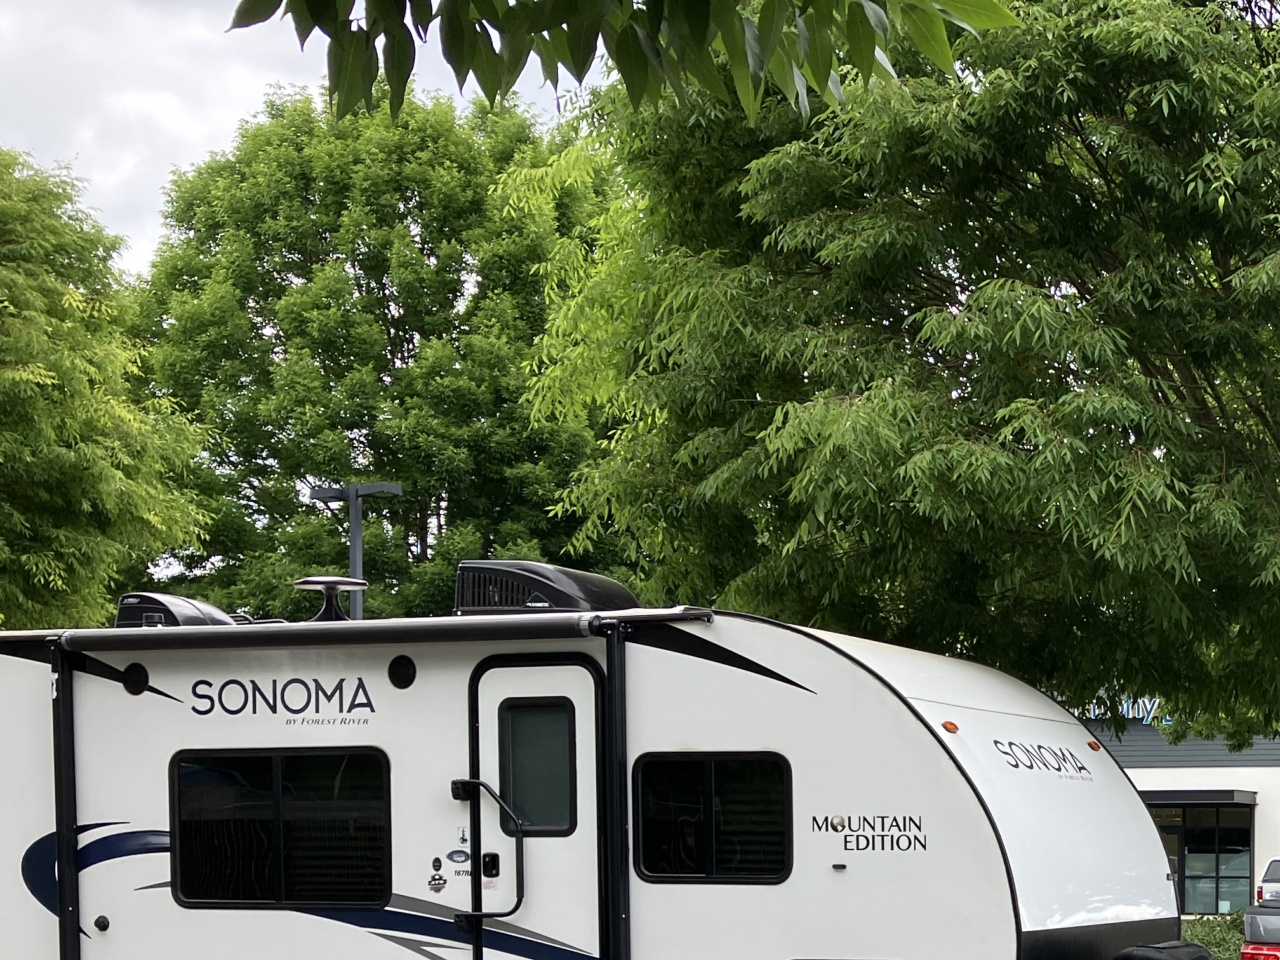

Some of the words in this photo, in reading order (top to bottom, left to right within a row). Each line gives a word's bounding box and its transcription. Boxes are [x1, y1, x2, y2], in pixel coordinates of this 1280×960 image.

[191, 677, 375, 715] SONOMA
[285, 718, 299, 726] BY
[301, 717, 338, 726] FOREST
[339, 717, 370, 726] RIVER
[993, 739, 1092, 775] SONOMA
[812, 815, 922, 833] MOUNTAIN
[844, 834, 927, 851] EDITION
